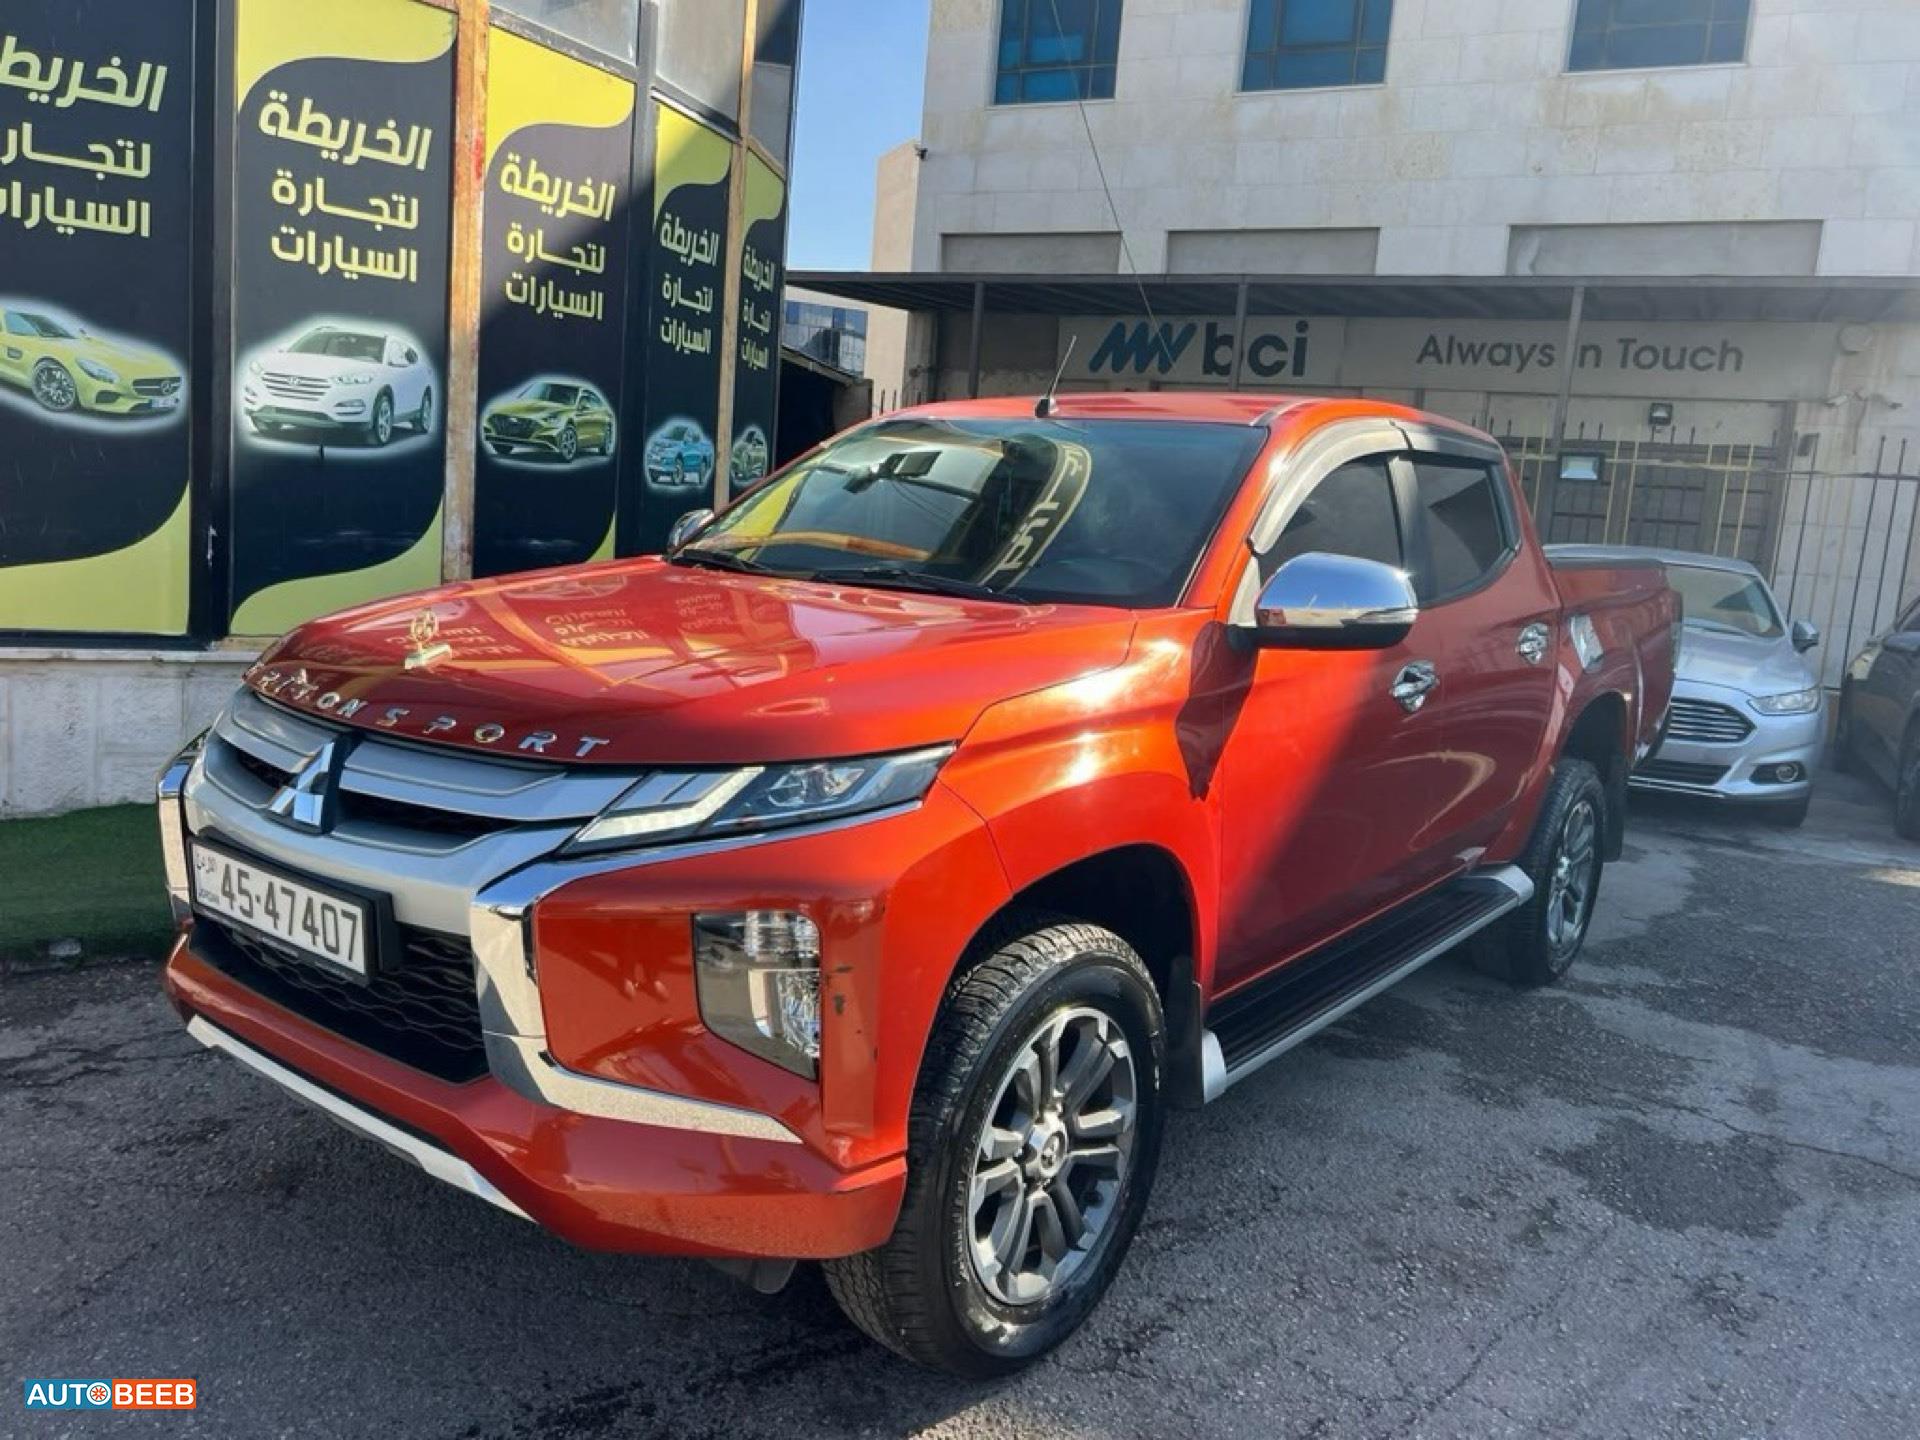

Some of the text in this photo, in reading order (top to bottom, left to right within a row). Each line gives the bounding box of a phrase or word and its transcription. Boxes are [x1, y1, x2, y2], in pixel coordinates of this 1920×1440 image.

[0, 35, 168, 112] الخريط
[0, 121, 151, 181] لتجار
[258, 89, 433, 171] الخريطة
[0, 181, 151, 238] السيارا
[271, 169, 419, 231] لتجارة
[500, 152, 616, 222] الخريطة
[271, 226, 418, 283] السيارات
[507, 222, 606, 275] لتجارة
[660, 212, 720, 267] الخريطة
[505, 271, 604, 321] السيارات
[662, 273, 714, 316] لتجارة
[660, 316, 712, 354] السيارات
[1203, 320, 1309, 378] bci
[1416, 333, 1556, 374] Always
[1617, 336, 1745, 373] Touch
[375, 707, 611, 758] SPORT
